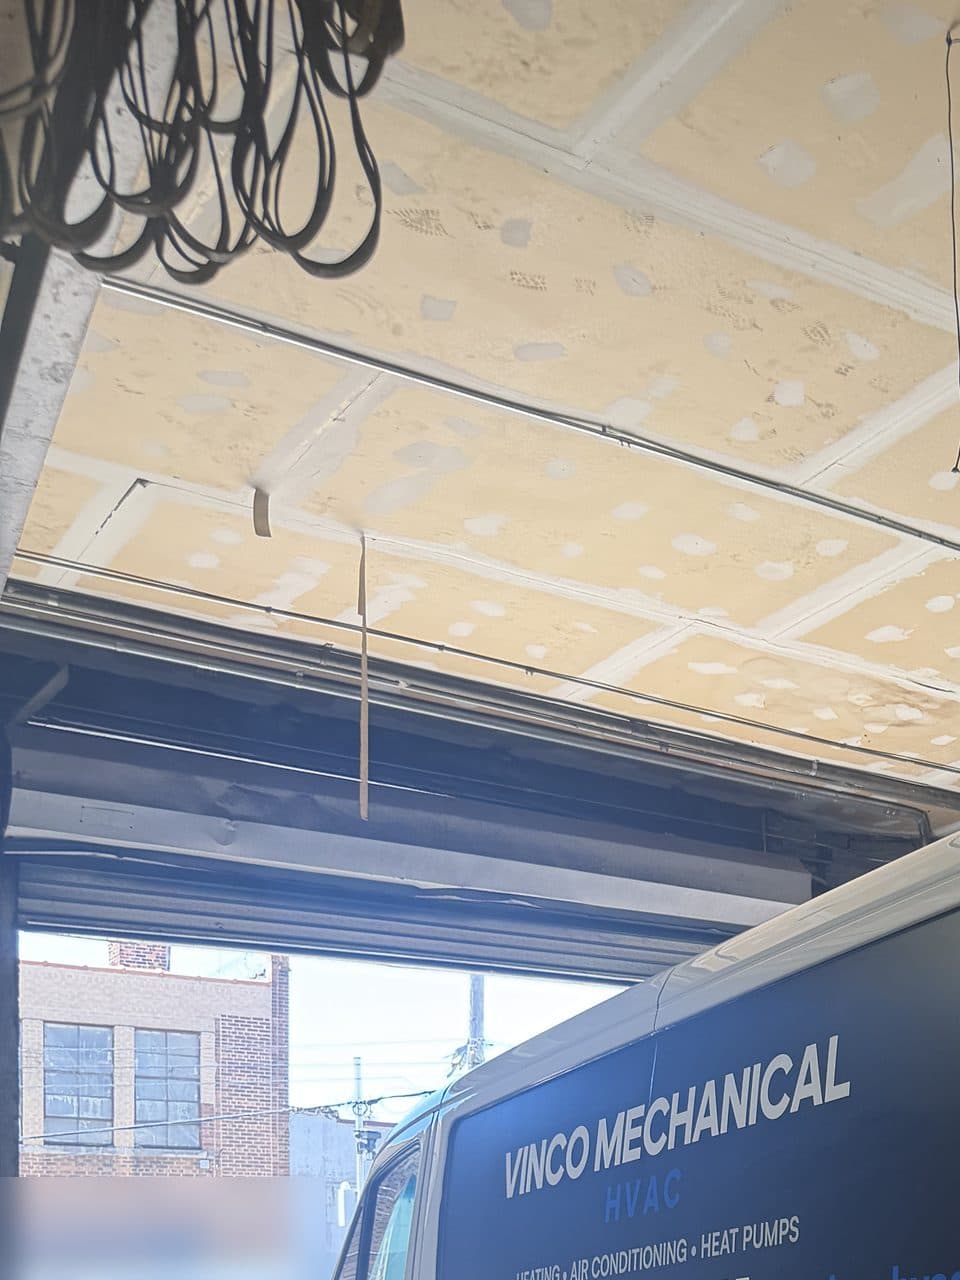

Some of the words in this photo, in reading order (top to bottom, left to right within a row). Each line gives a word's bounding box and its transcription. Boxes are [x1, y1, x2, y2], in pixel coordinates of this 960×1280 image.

[505, 1125, 590, 1199] VINCO
[593, 1035, 851, 1172] MECHANICAL
[604, 1168, 682, 1223] HVAC
[591, 1238, 687, 1277] CONDITIONING
[700, 1228, 740, 1258] HEAT
[743, 1216, 800, 1249] PUMPS
